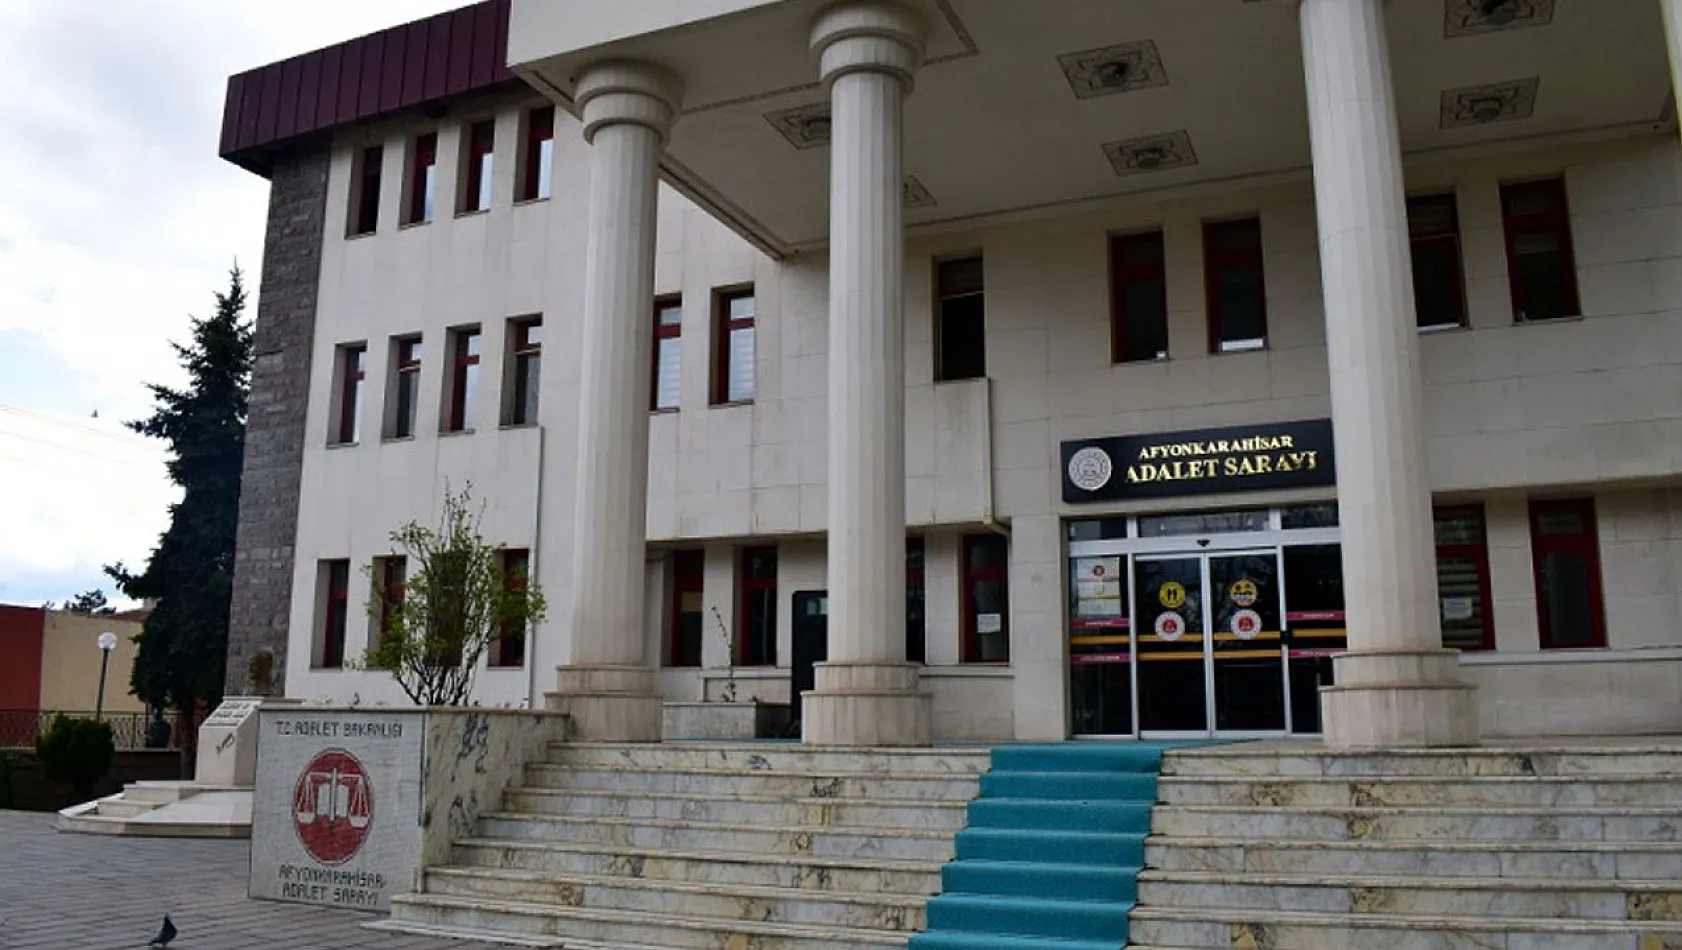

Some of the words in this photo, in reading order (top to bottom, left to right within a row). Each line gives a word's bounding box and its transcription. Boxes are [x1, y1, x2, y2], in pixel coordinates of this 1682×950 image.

[1139, 435, 1293, 459] AFYONKARAHİSAR
[1126, 459, 1218, 483] ADALET
[1224, 451, 1317, 476] SARAYI
[295, 720, 340, 737] ADALET
[282, 883, 327, 900] ADALET
